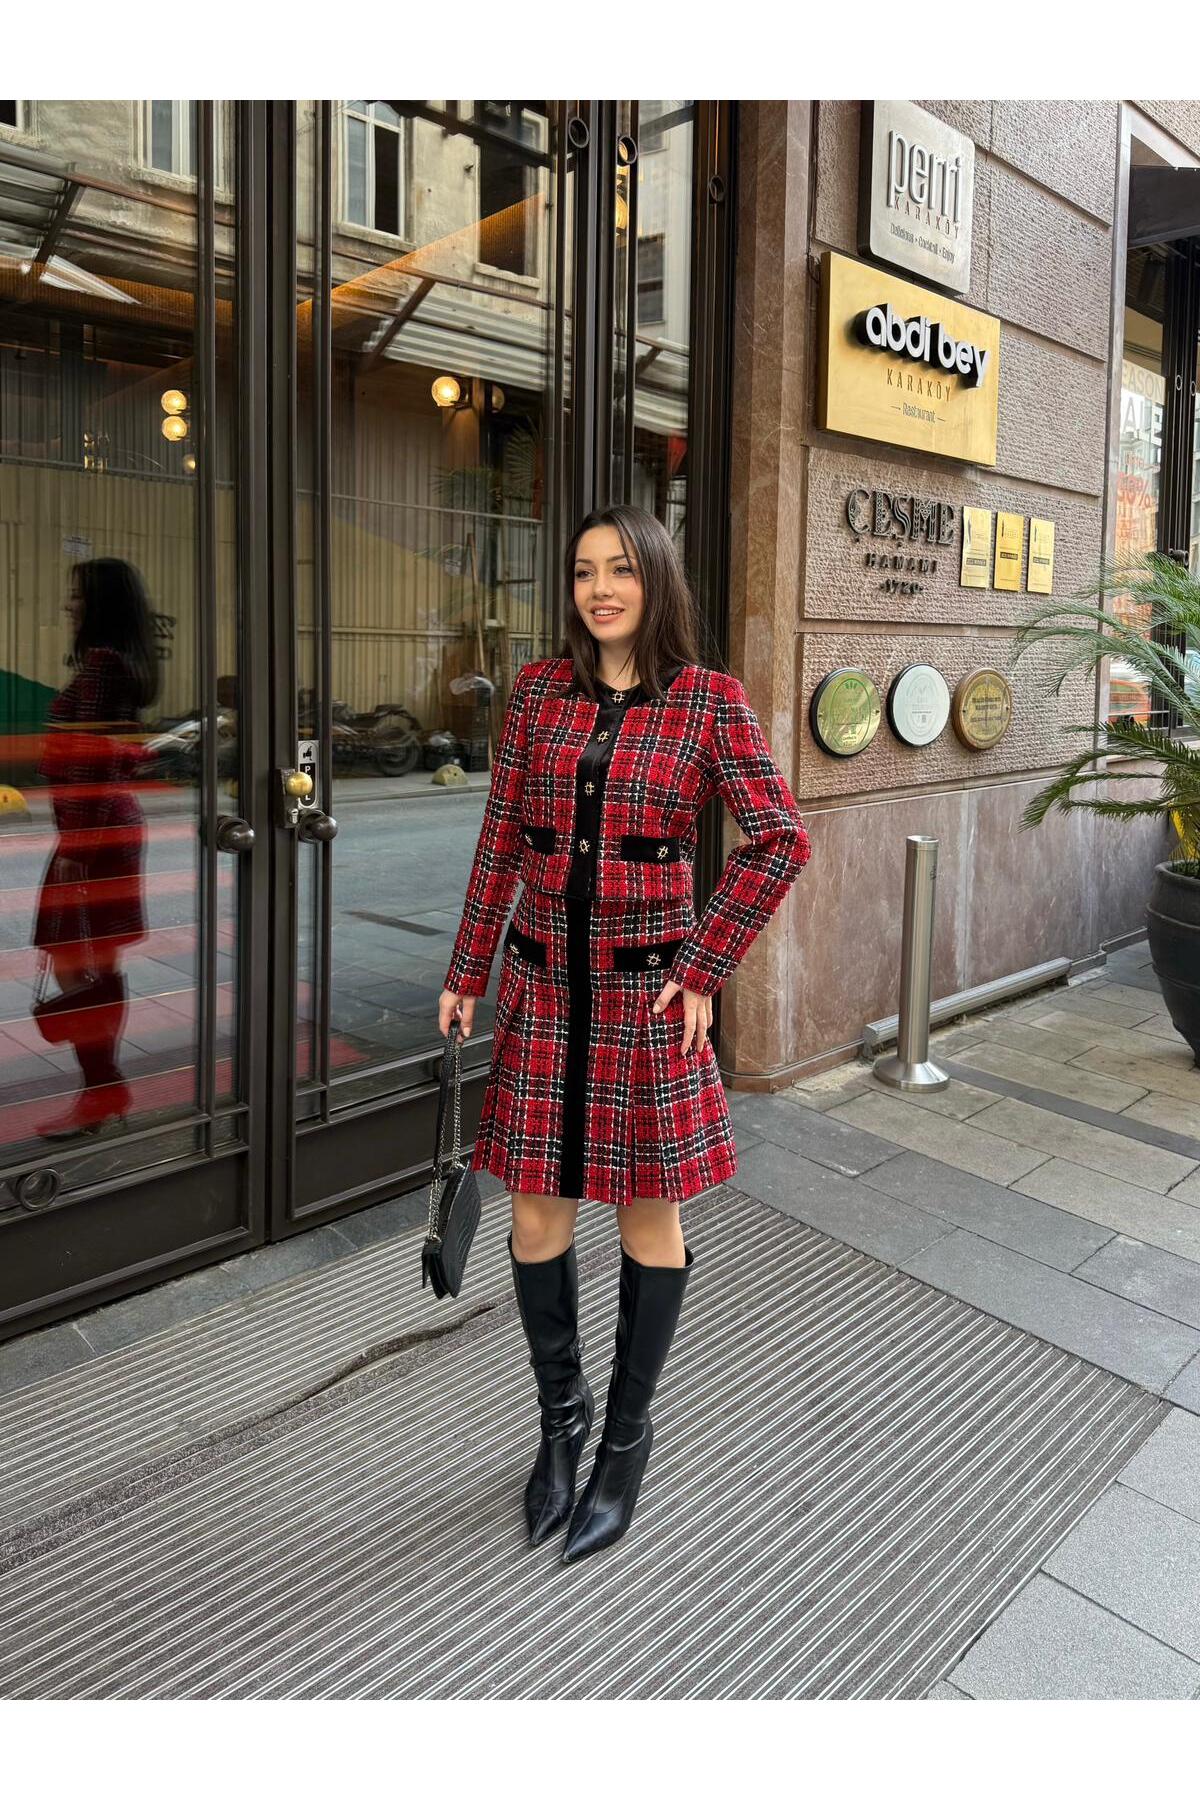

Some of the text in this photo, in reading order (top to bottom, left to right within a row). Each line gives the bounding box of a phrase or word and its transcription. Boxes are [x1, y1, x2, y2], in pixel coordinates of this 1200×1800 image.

[894, 194, 959, 239] KARAKÖY
[863, 302, 990, 387] abdi bey
[887, 368, 951, 402] KARAKÖY
